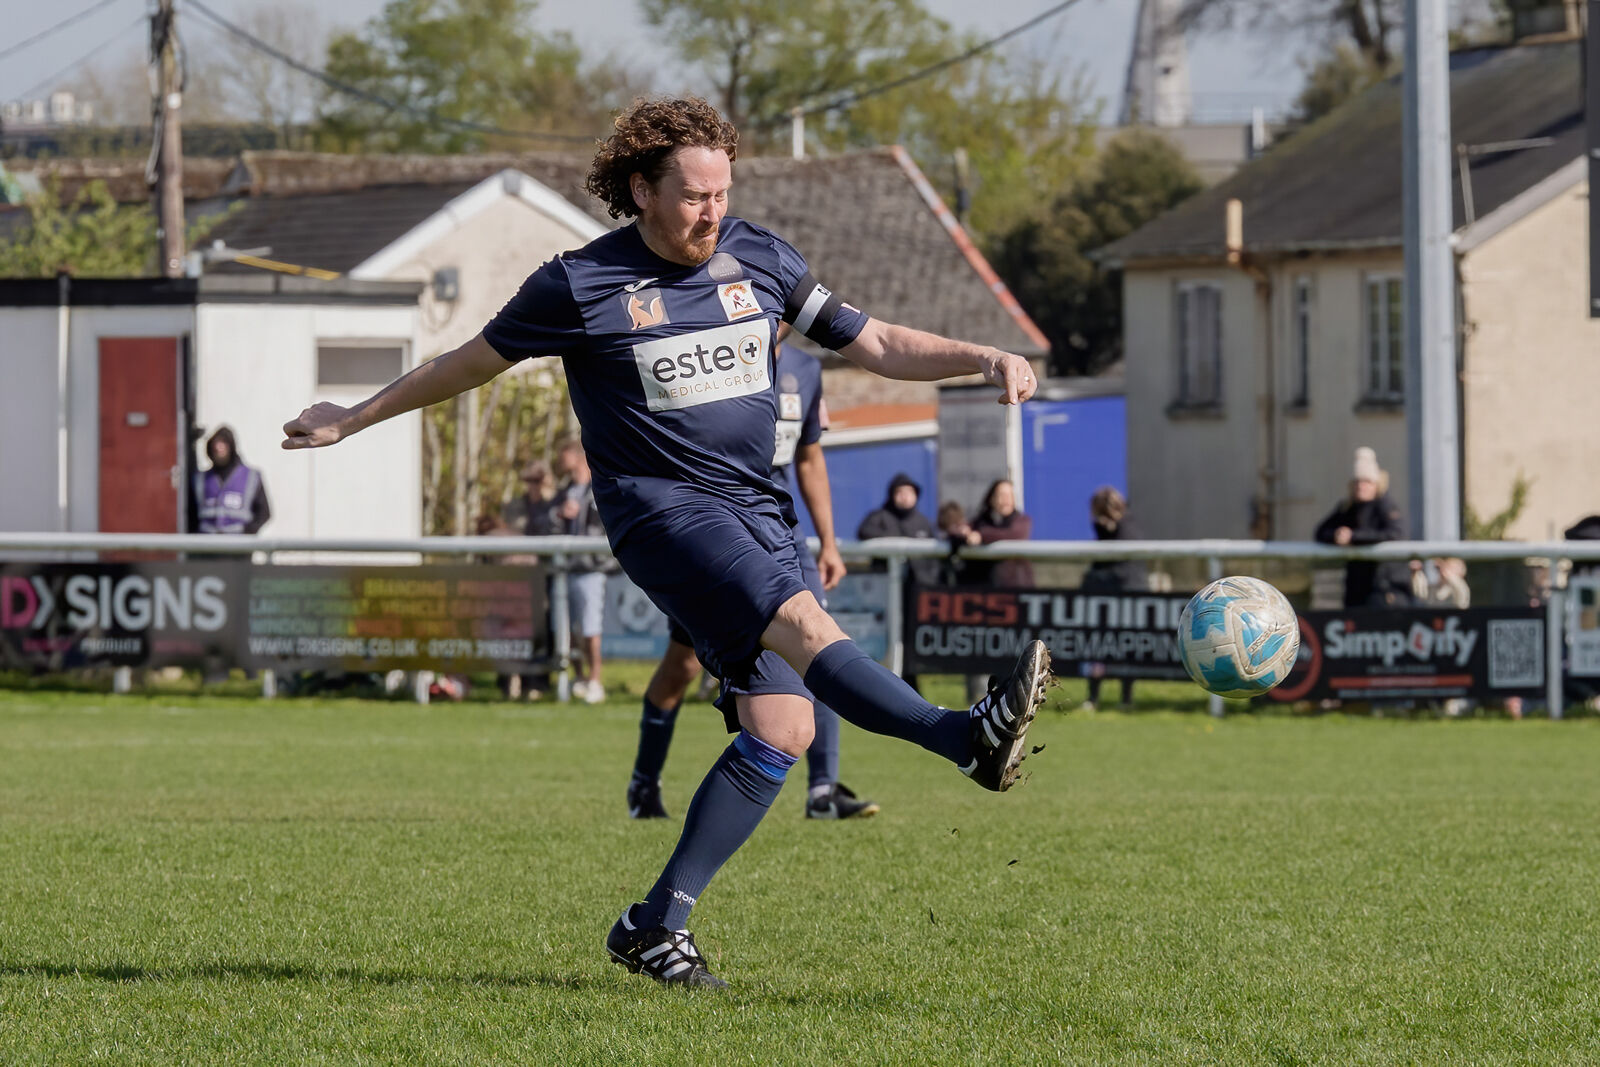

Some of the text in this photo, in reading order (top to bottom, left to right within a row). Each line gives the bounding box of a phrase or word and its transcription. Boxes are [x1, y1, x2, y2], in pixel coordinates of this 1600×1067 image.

[652, 344, 735, 383] este
[657, 369, 764, 400] MEDICAL GROUP
[65, 574, 228, 631] SIGNS
[915, 625, 1182, 661] CUSTOM REMAPPIN
[673, 890, 697, 905] Jom
